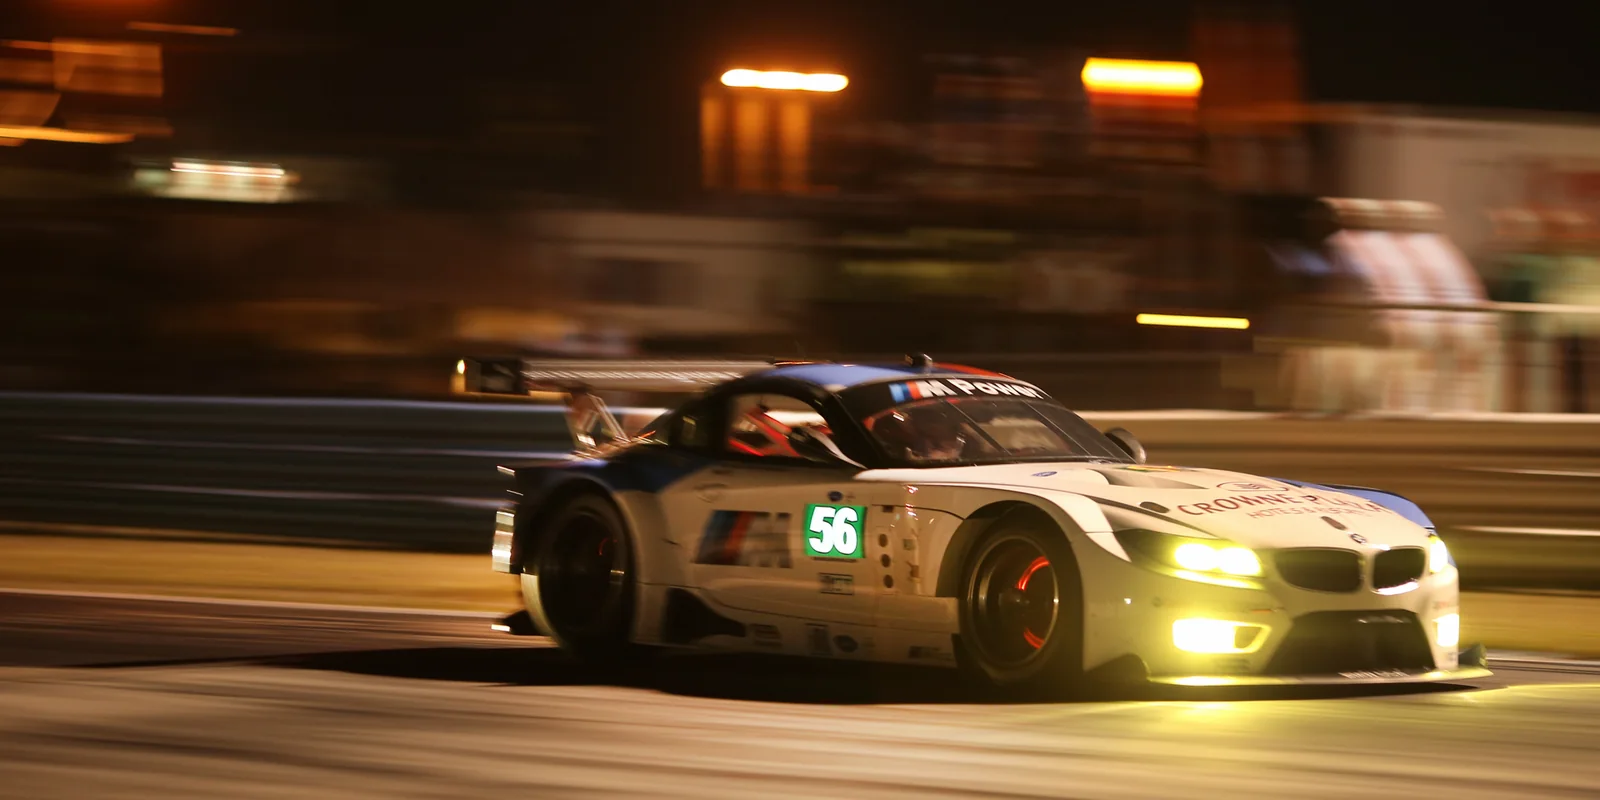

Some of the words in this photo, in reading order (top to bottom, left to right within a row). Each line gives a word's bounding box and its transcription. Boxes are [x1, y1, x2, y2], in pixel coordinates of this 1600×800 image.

[946, 378, 1045, 400] Power
[1177, 493, 1303, 516] CROWNE
[808, 506, 858, 555] 56
